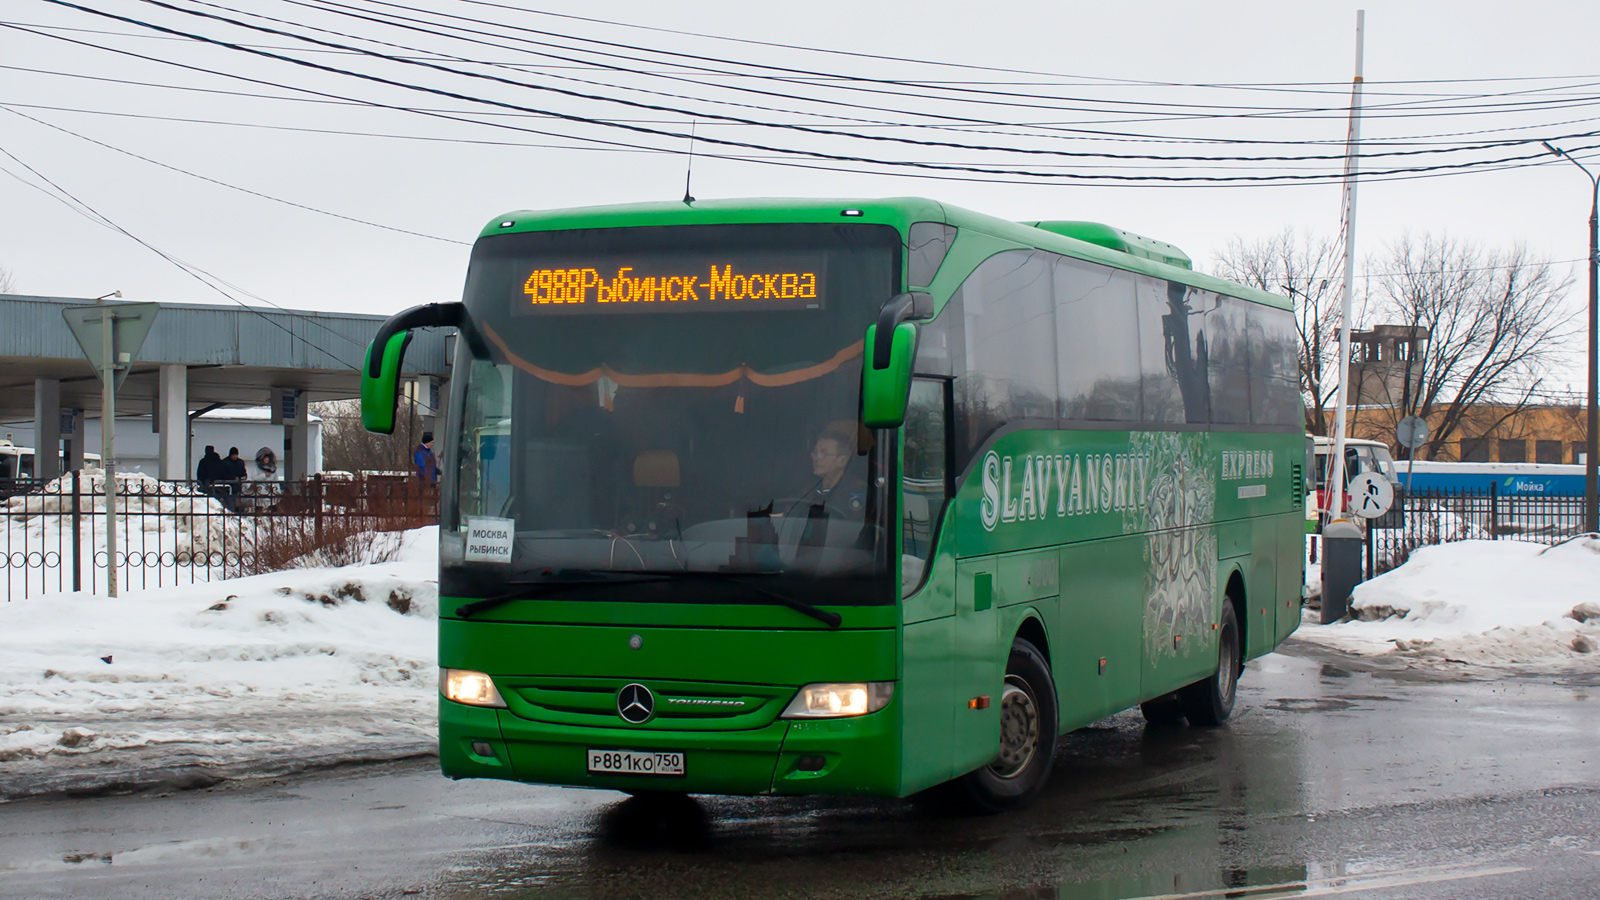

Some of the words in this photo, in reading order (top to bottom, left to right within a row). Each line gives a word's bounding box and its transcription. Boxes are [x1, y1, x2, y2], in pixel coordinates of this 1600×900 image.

[980, 450, 1150, 532] SLAVYANSKIY
[1221, 450, 1274, 480] EXPRESS
[1516, 481, 1544, 491] Мойка
[472, 529, 508, 539] МОСКВА
[469, 545, 509, 555] РЫБИНСК
[668, 698, 745, 707] TOURISMO
